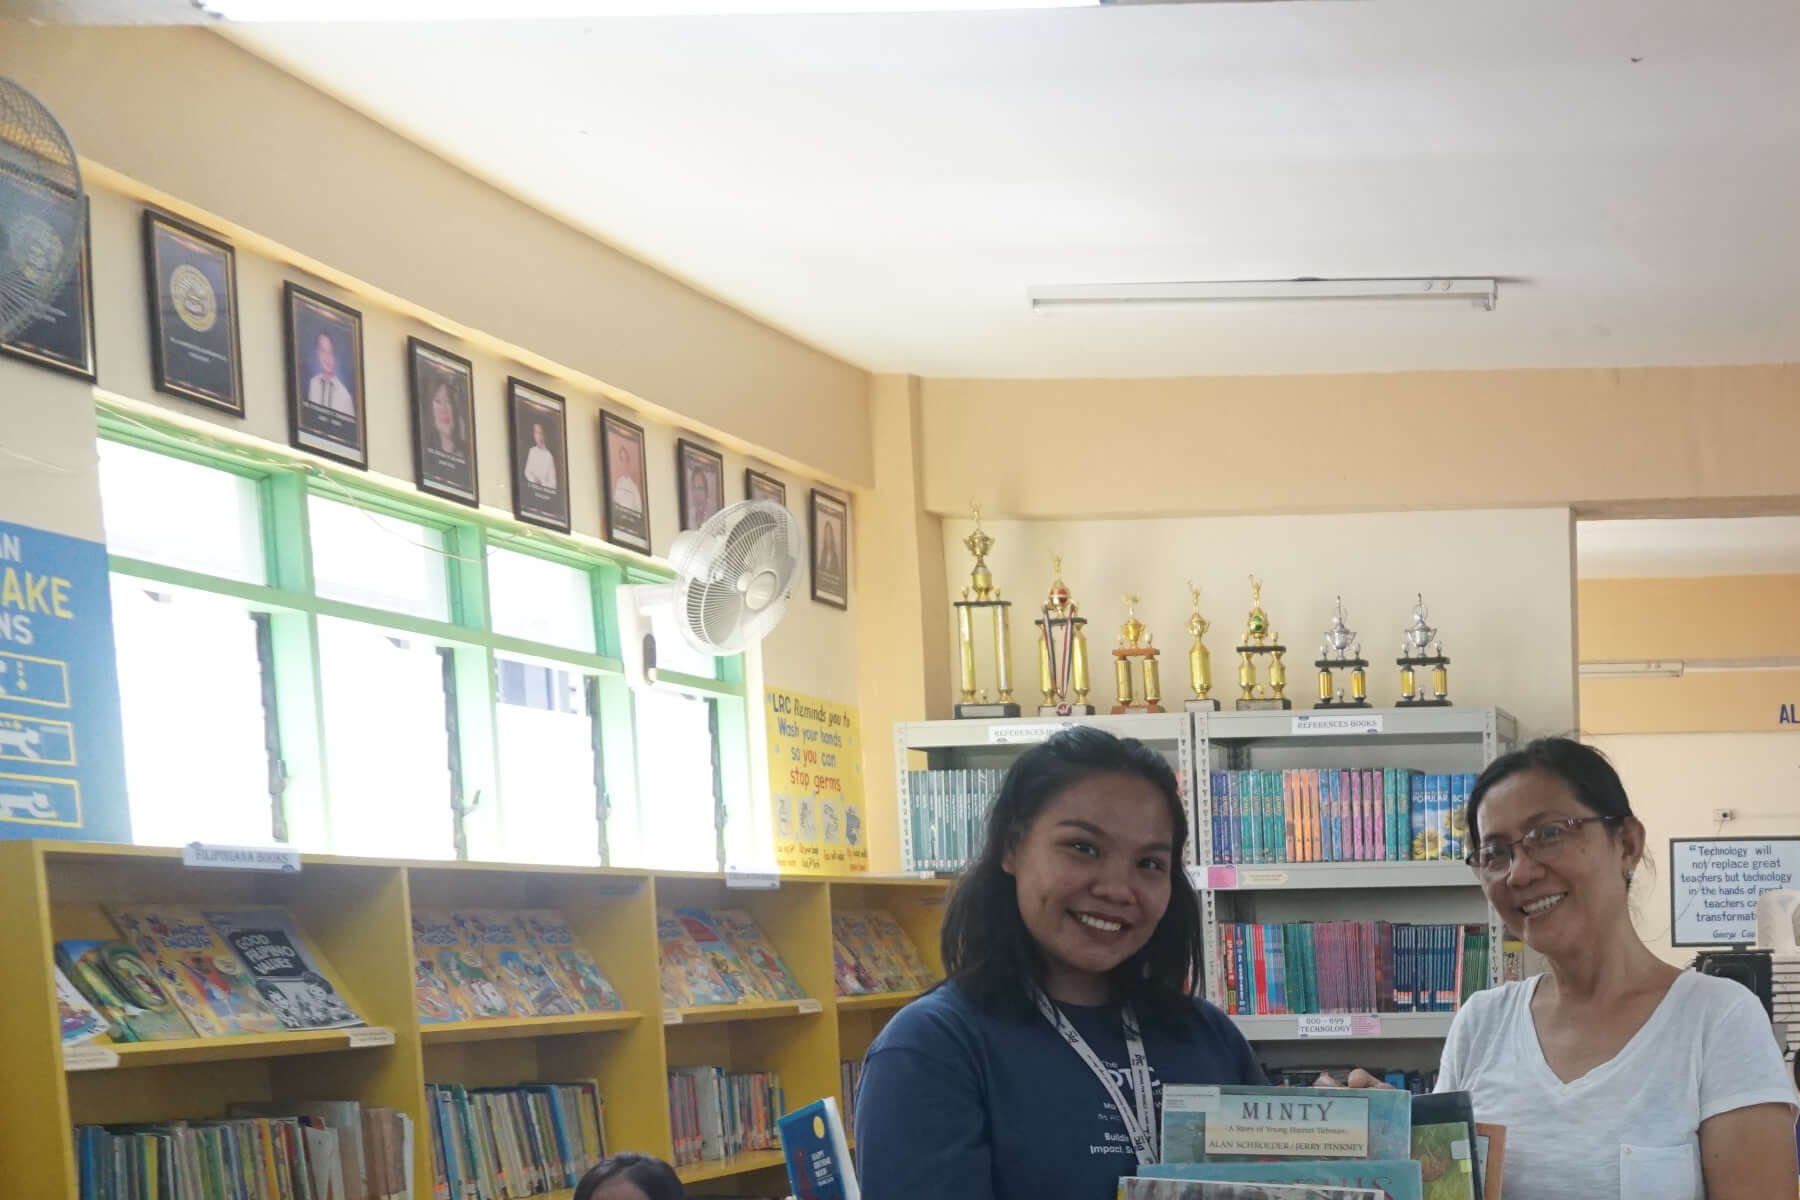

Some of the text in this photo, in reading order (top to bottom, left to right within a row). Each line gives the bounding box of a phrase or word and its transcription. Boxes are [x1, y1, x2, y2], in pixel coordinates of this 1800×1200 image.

[773, 693, 851, 728] LRC Reminds you to
[777, 717, 799, 737] Wash
[802, 727, 818, 745] your
[791, 746, 836, 768] so you can
[790, 767, 810, 790] stop
[1755, 845, 1772, 856] will
[1692, 858, 1781, 870] not replace great
[1681, 871, 1792, 883] teachers but technology
[1688, 885, 1783, 897] in the hands of grt
[1704, 898, 1757, 908] teachers ca
[1696, 911, 1757, 922] transformat
[1301, 1025, 1350, 1033] TECHNOLOGY
[1242, 1101, 1335, 1122] MINTY
[1266, 1125, 1287, 1135] Young
[1208, 1140, 1233, 1148] ALAN
[1323, 1143, 1364, 1151] PINKNEY
